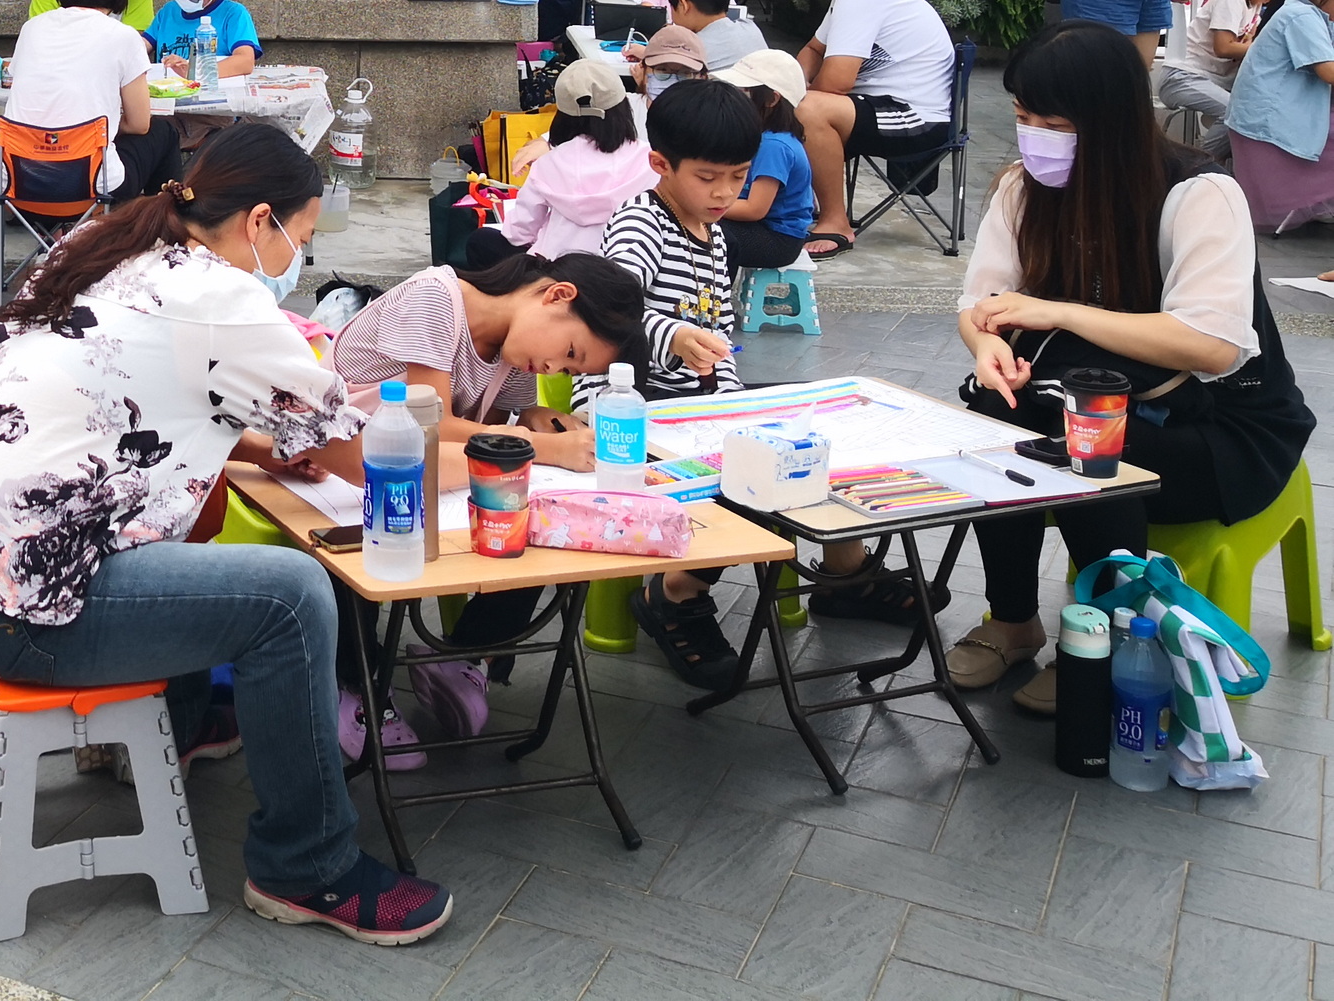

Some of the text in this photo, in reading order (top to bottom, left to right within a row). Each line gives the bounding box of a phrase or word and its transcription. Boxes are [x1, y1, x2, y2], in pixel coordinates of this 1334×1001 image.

[600, 416, 620, 432] ion
[599, 430, 639, 444] water
[391, 485, 408, 495] PH
[1121, 707, 1142, 725] PH
[1119, 721, 1143, 741] 9.0
